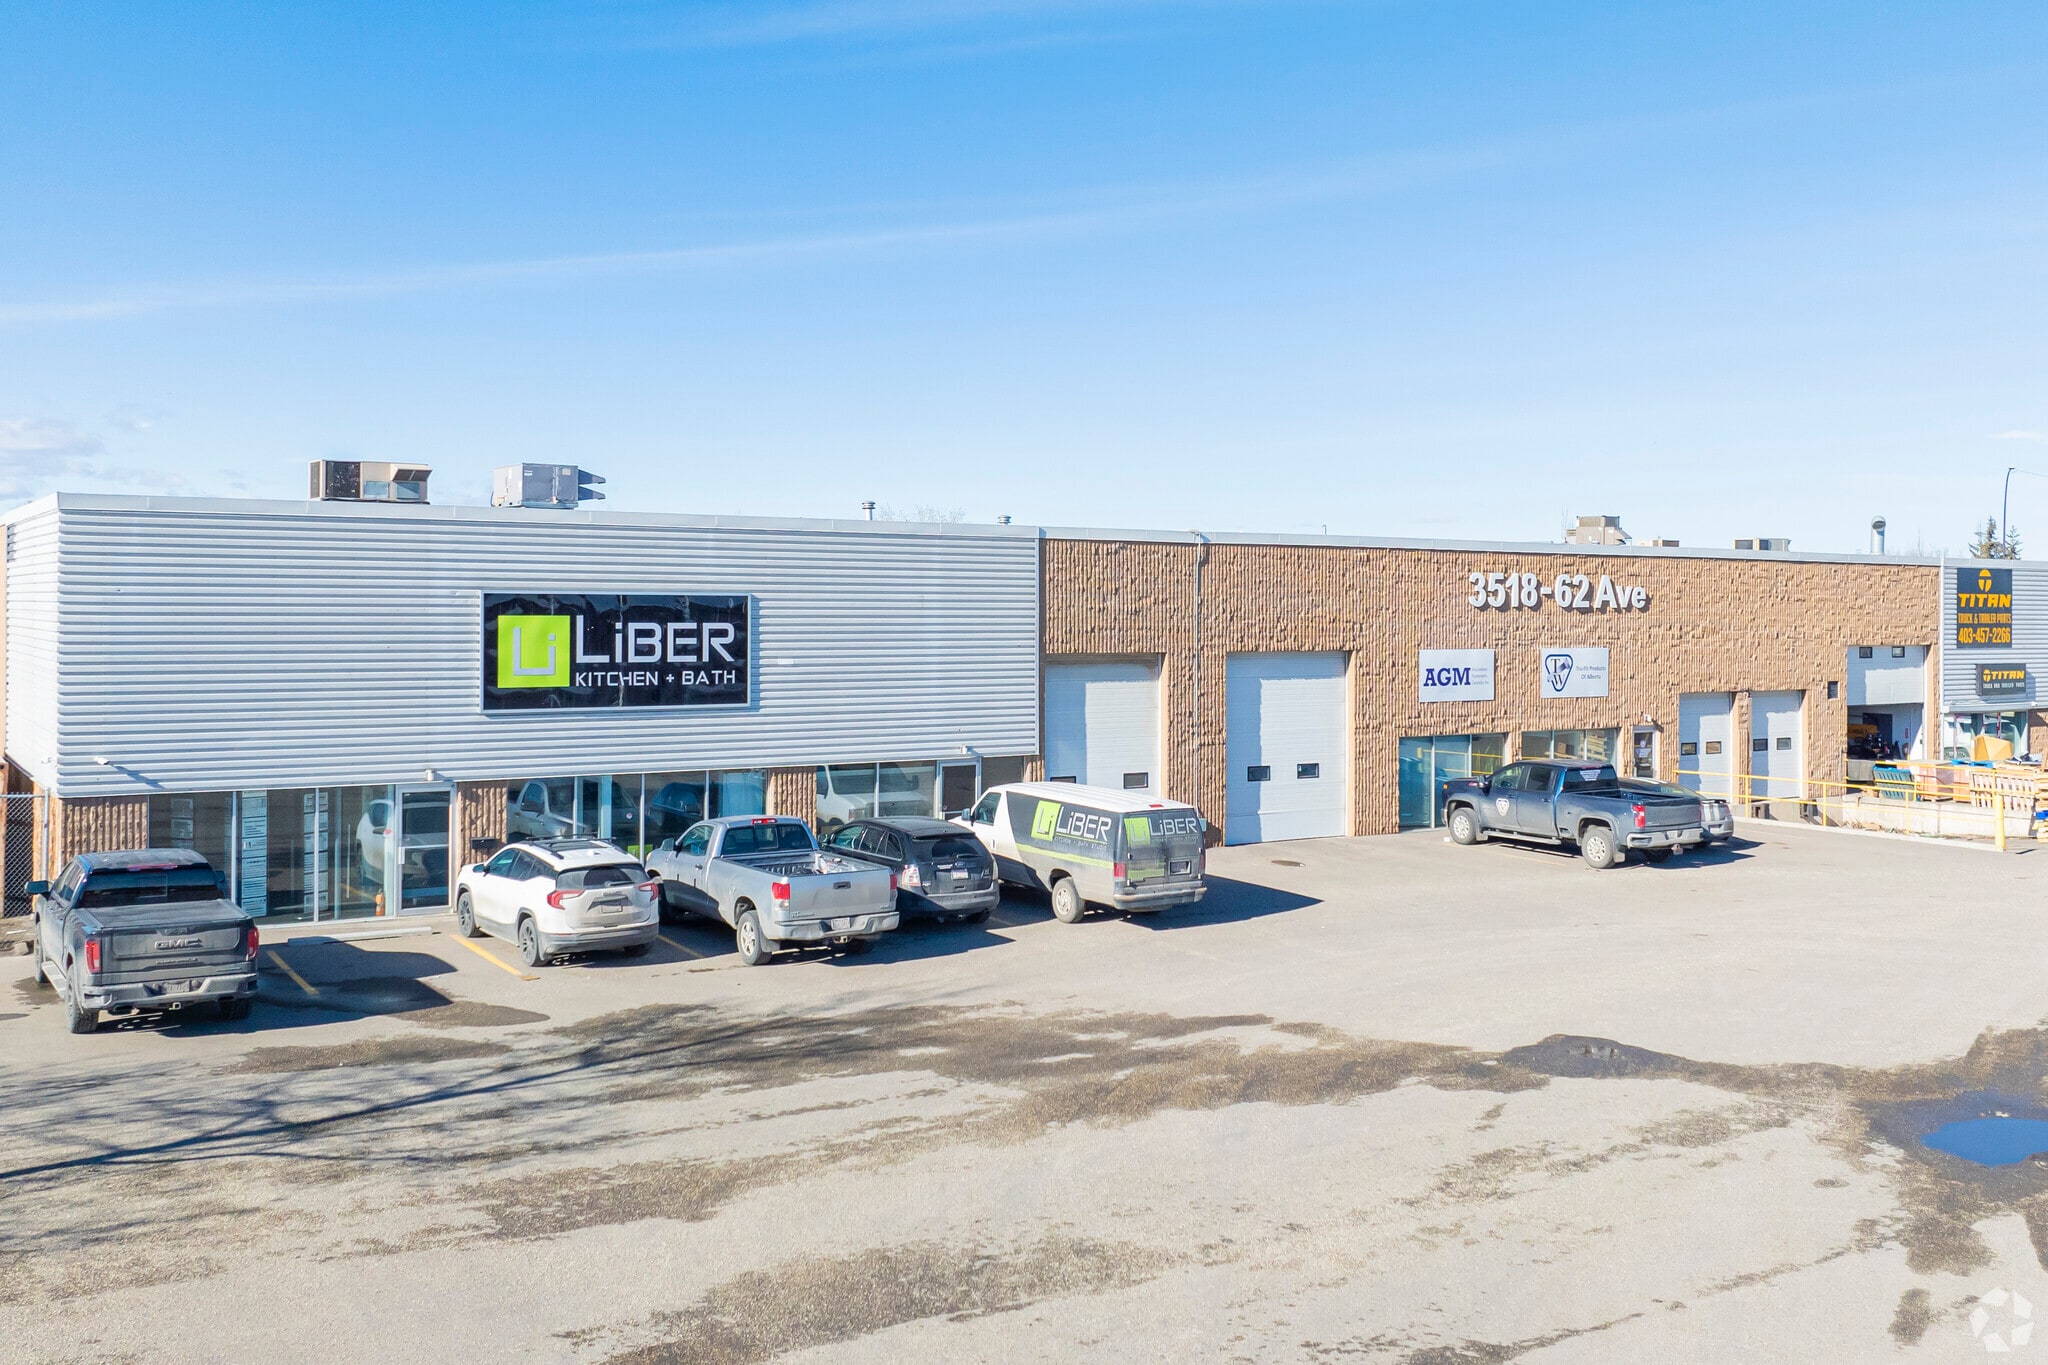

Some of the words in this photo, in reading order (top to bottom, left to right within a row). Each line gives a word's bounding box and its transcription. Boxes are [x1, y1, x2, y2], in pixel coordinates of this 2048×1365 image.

[1595, 575, 1647, 608] Ave
[1958, 593, 2011, 608] TITAN
[1958, 627, 2011, 643] 403-457-2266
[576, 671, 659, 687] KITCHEN
[682, 670, 736, 685] BATH
[1423, 667, 1471, 687] AGM
[1991, 670, 2025, 680] TITAN
[155, 938, 202, 950] GMC
